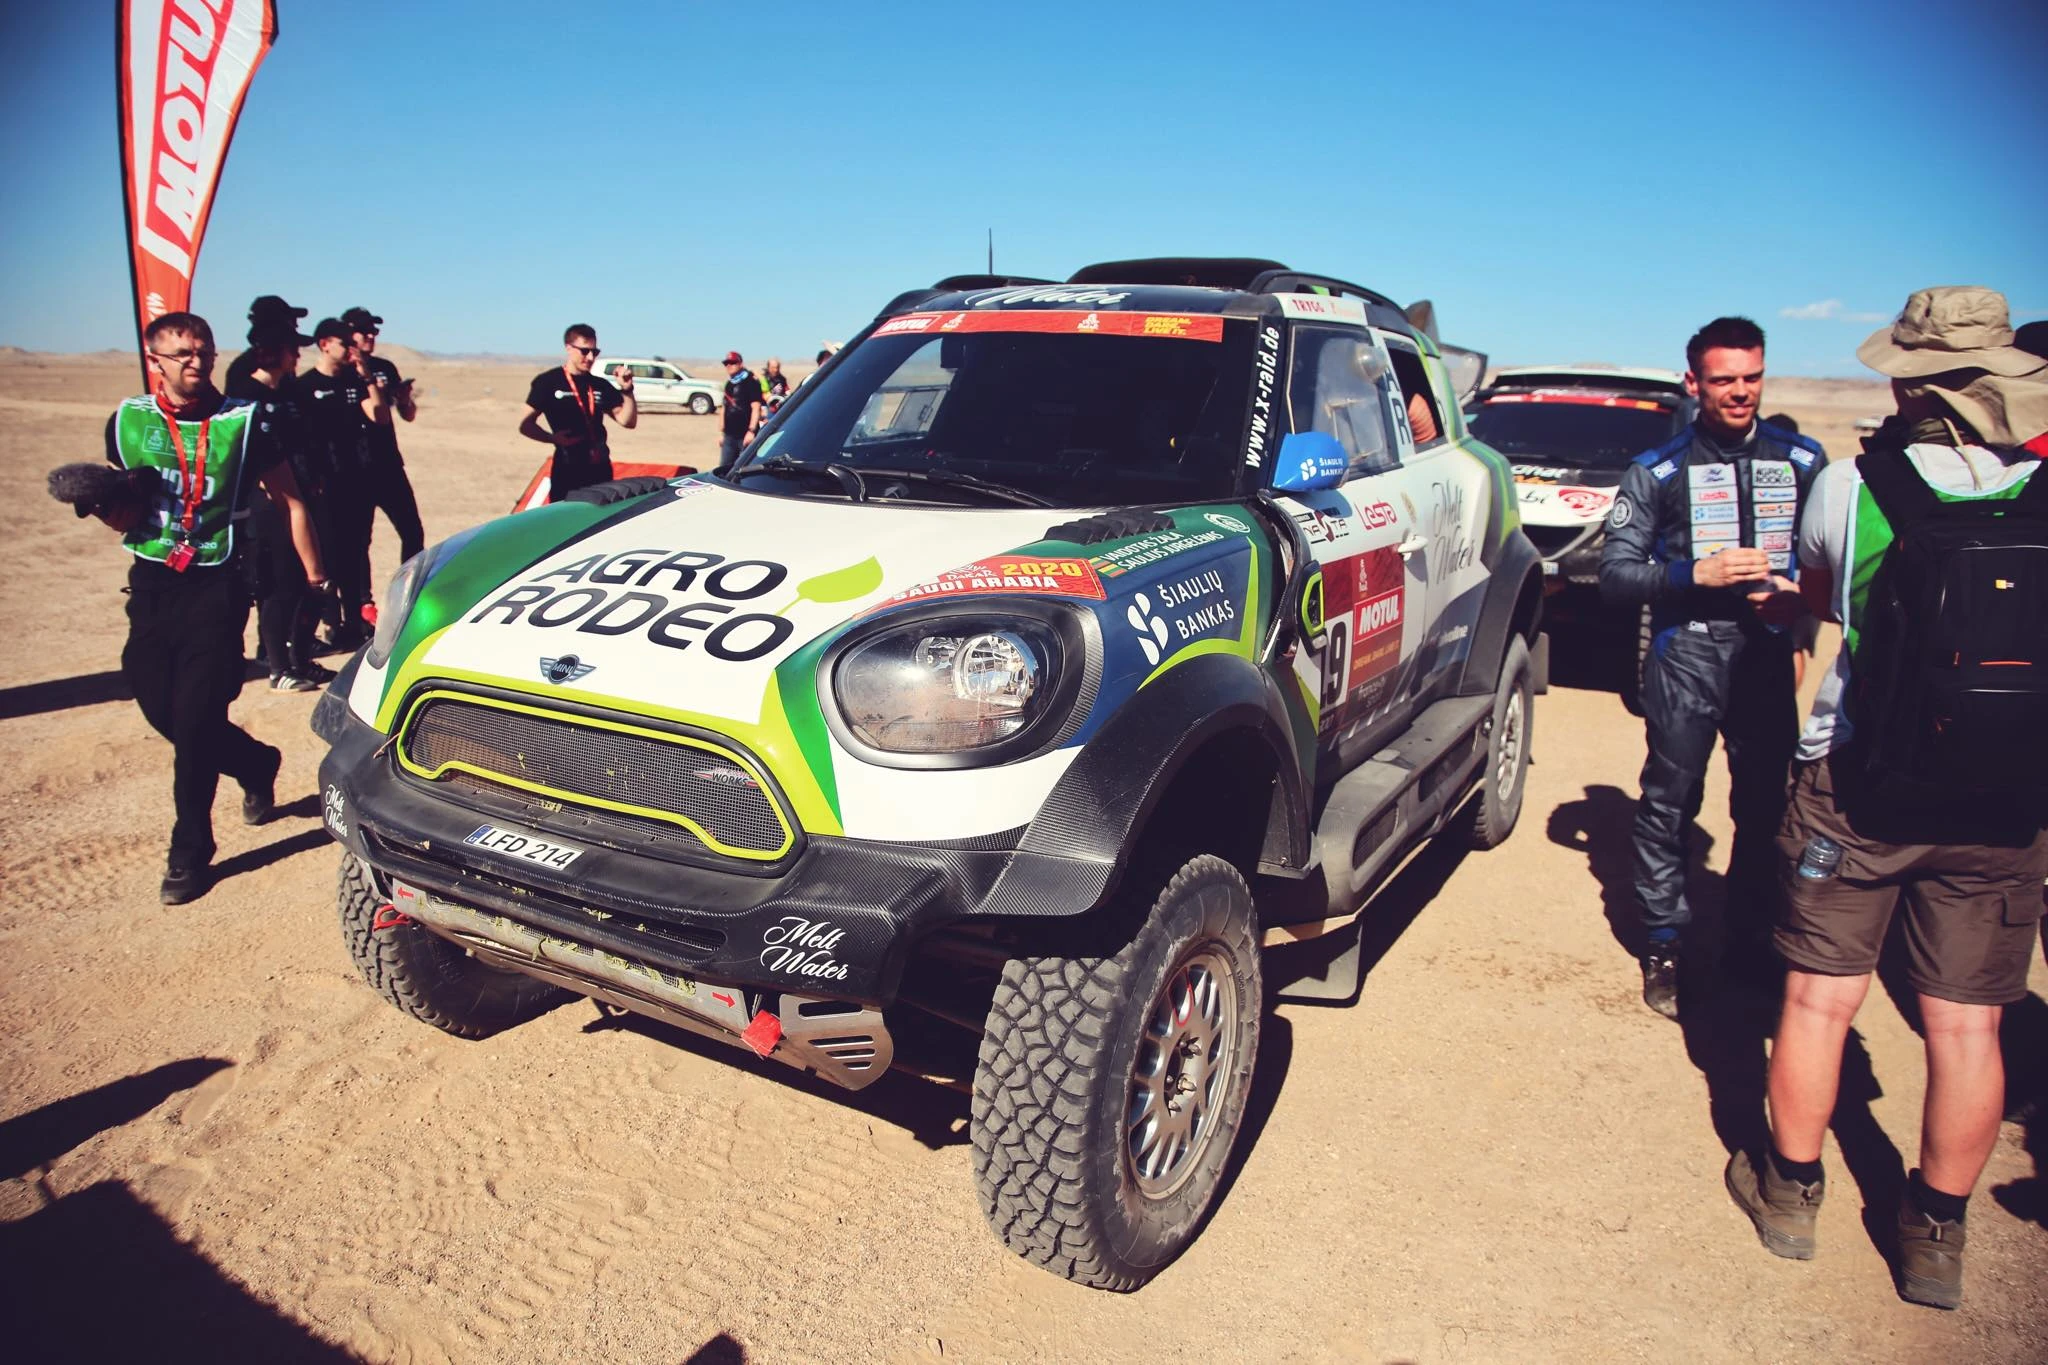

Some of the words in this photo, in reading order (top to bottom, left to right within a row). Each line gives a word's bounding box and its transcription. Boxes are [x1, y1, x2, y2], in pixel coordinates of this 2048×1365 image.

[155, 0, 225, 243] MOTU
[879, 317, 933, 333] MOTUL
[1246, 326, 1280, 469] www.x-raid.de
[1100, 536, 1156, 562] VAIDOTAS
[1152, 531, 1185, 545] ŽALA
[1117, 547, 1169, 570] SAULIUS
[528, 549, 788, 601] AGRO
[1000, 562, 1084, 577] 2020
[892, 579, 964, 600] SAUDI
[971, 576, 1059, 589] ARABIA
[1157, 569, 1224, 609] ŠIAULIŲ
[469, 585, 794, 662] RODEO
[1175, 600, 1235, 639] BANKAS
[1358, 594, 1400, 637] MOTUL
[552, 662, 575, 675] MINI
[711, 772, 748, 787] WORKS
[478, 830, 529, 853] LFD
[524, 843, 575, 867] 214
[763, 916, 847, 950] Melt
[760, 945, 849, 980] Water
